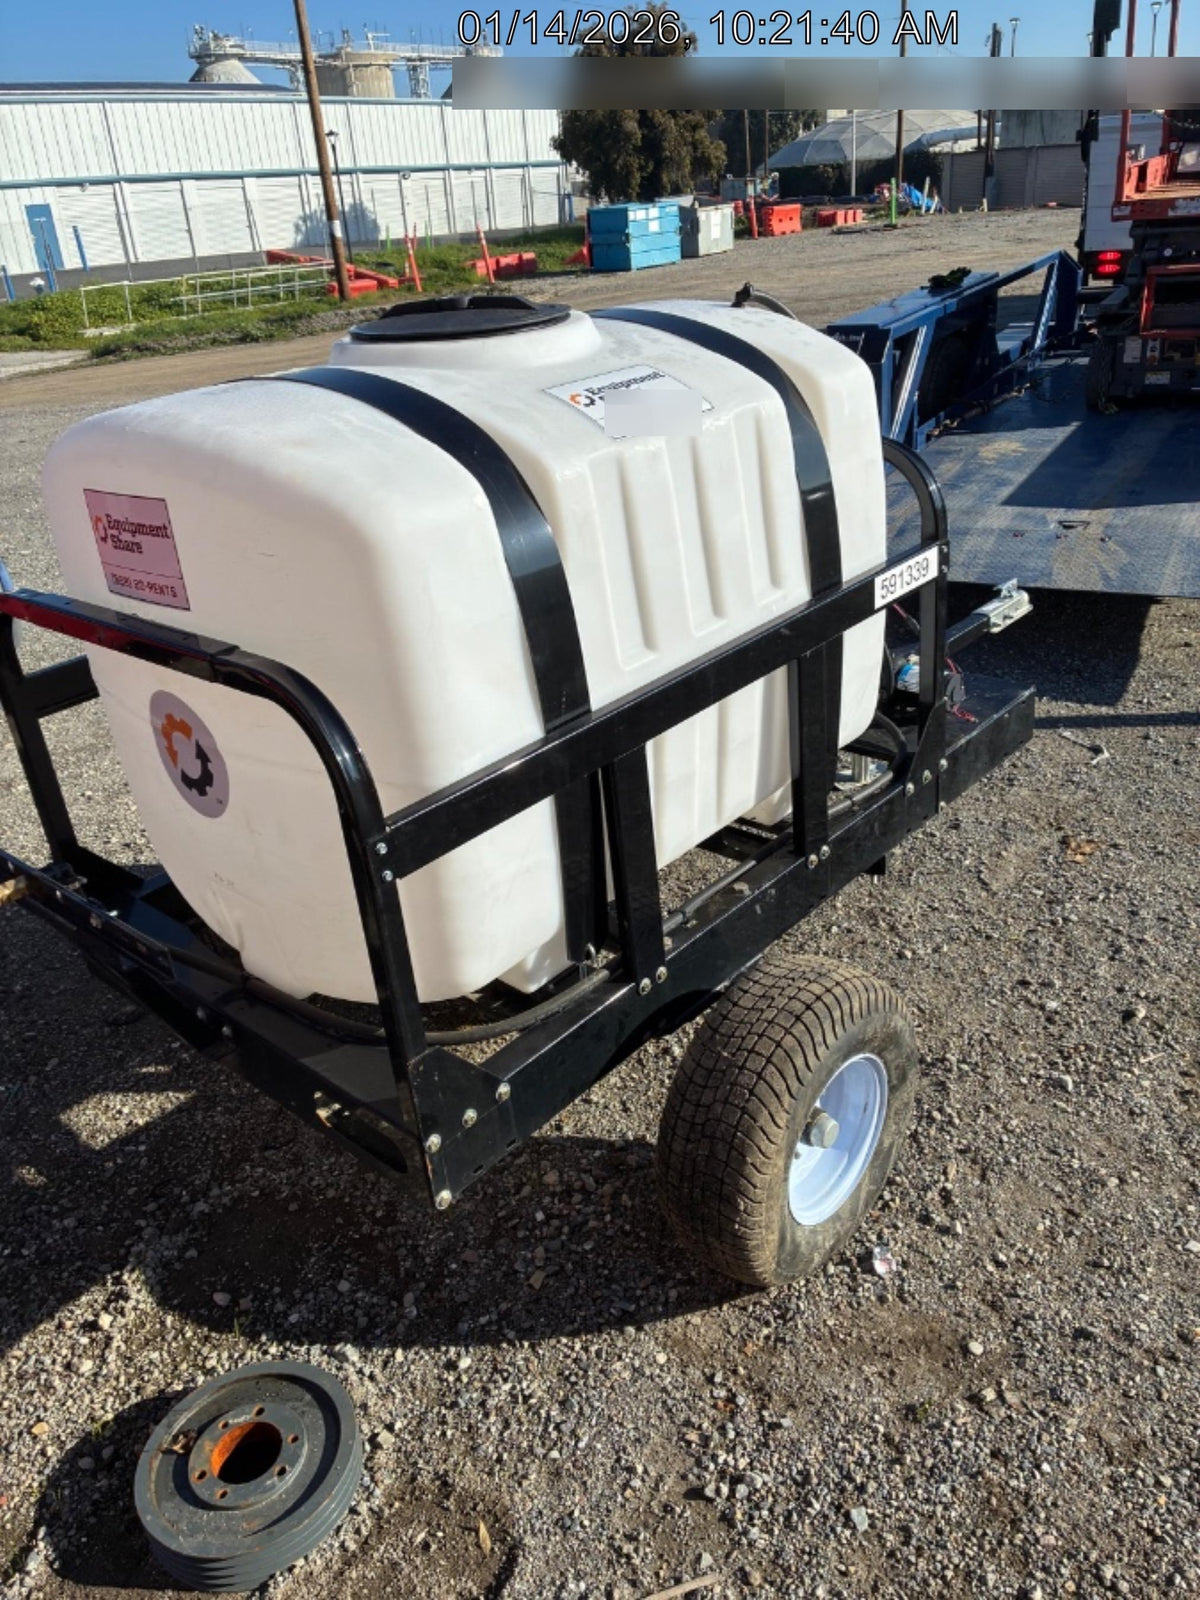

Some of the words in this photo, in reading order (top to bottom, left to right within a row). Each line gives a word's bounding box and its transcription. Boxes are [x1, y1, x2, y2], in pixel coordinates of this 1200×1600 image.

[105, 512, 171, 539] Equipment
[110, 534, 143, 554] Share
[880, 557, 929, 600] 591339
